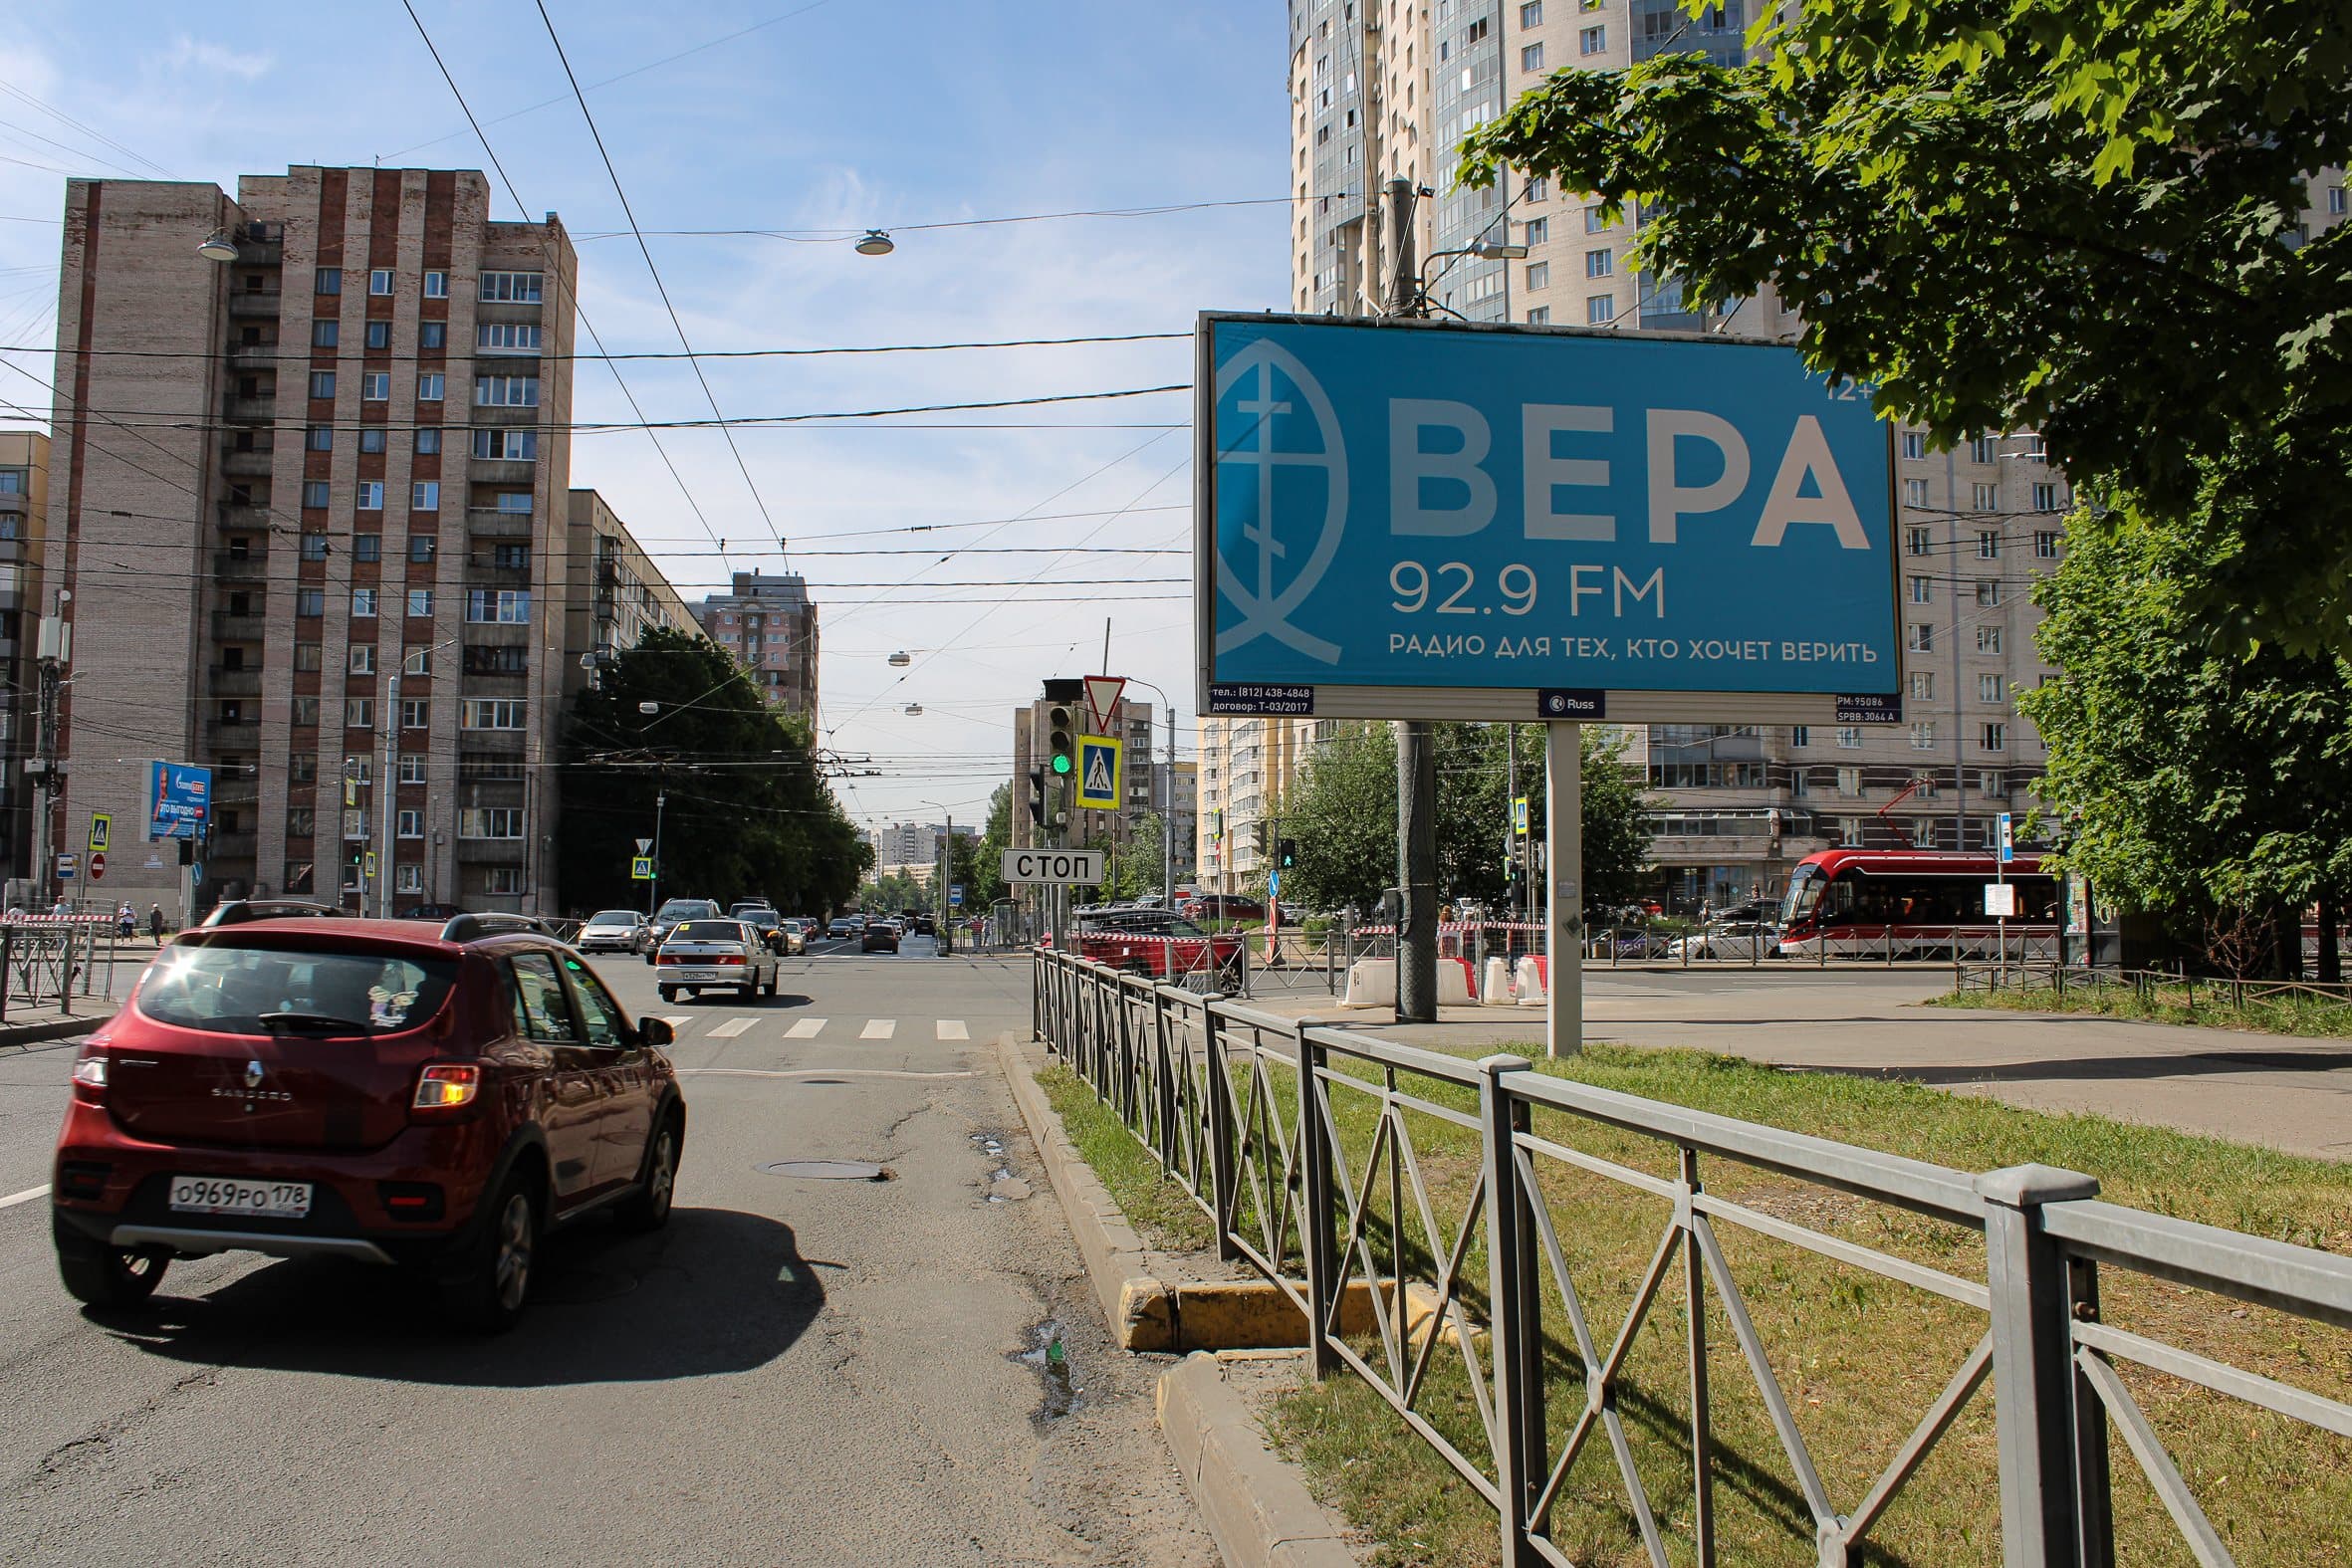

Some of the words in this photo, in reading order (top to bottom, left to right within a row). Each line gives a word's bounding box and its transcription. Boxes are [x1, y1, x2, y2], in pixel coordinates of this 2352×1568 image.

[1388, 397, 1872, 550] ВЕРА
[1389, 560, 1537, 615] 92.9
[1570, 564, 1664, 618] FM
[1389, 633, 1486, 659] РАДИО
[1494, 636, 1550, 659] ДЛЯ
[1560, 637, 1617, 661] ТЕХ,
[1626, 638, 1680, 659] КТО
[1688, 639, 1771, 661] ХОЧЕТ
[1780, 641, 1878, 663] ВЕРИТЬ
[1213, 688, 1237, 697] тел.:
[1239, 687, 1263, 698] (812)
[1265, 688, 1309, 698] 438-4848
[1212, 703, 1257, 713] договор:
[1567, 698, 1595, 710] Russ
[170, 803, 194, 815] ВЫГОДНО
[1017, 854, 1089, 878] СТОП
[272, 1185, 308, 1204] 178
